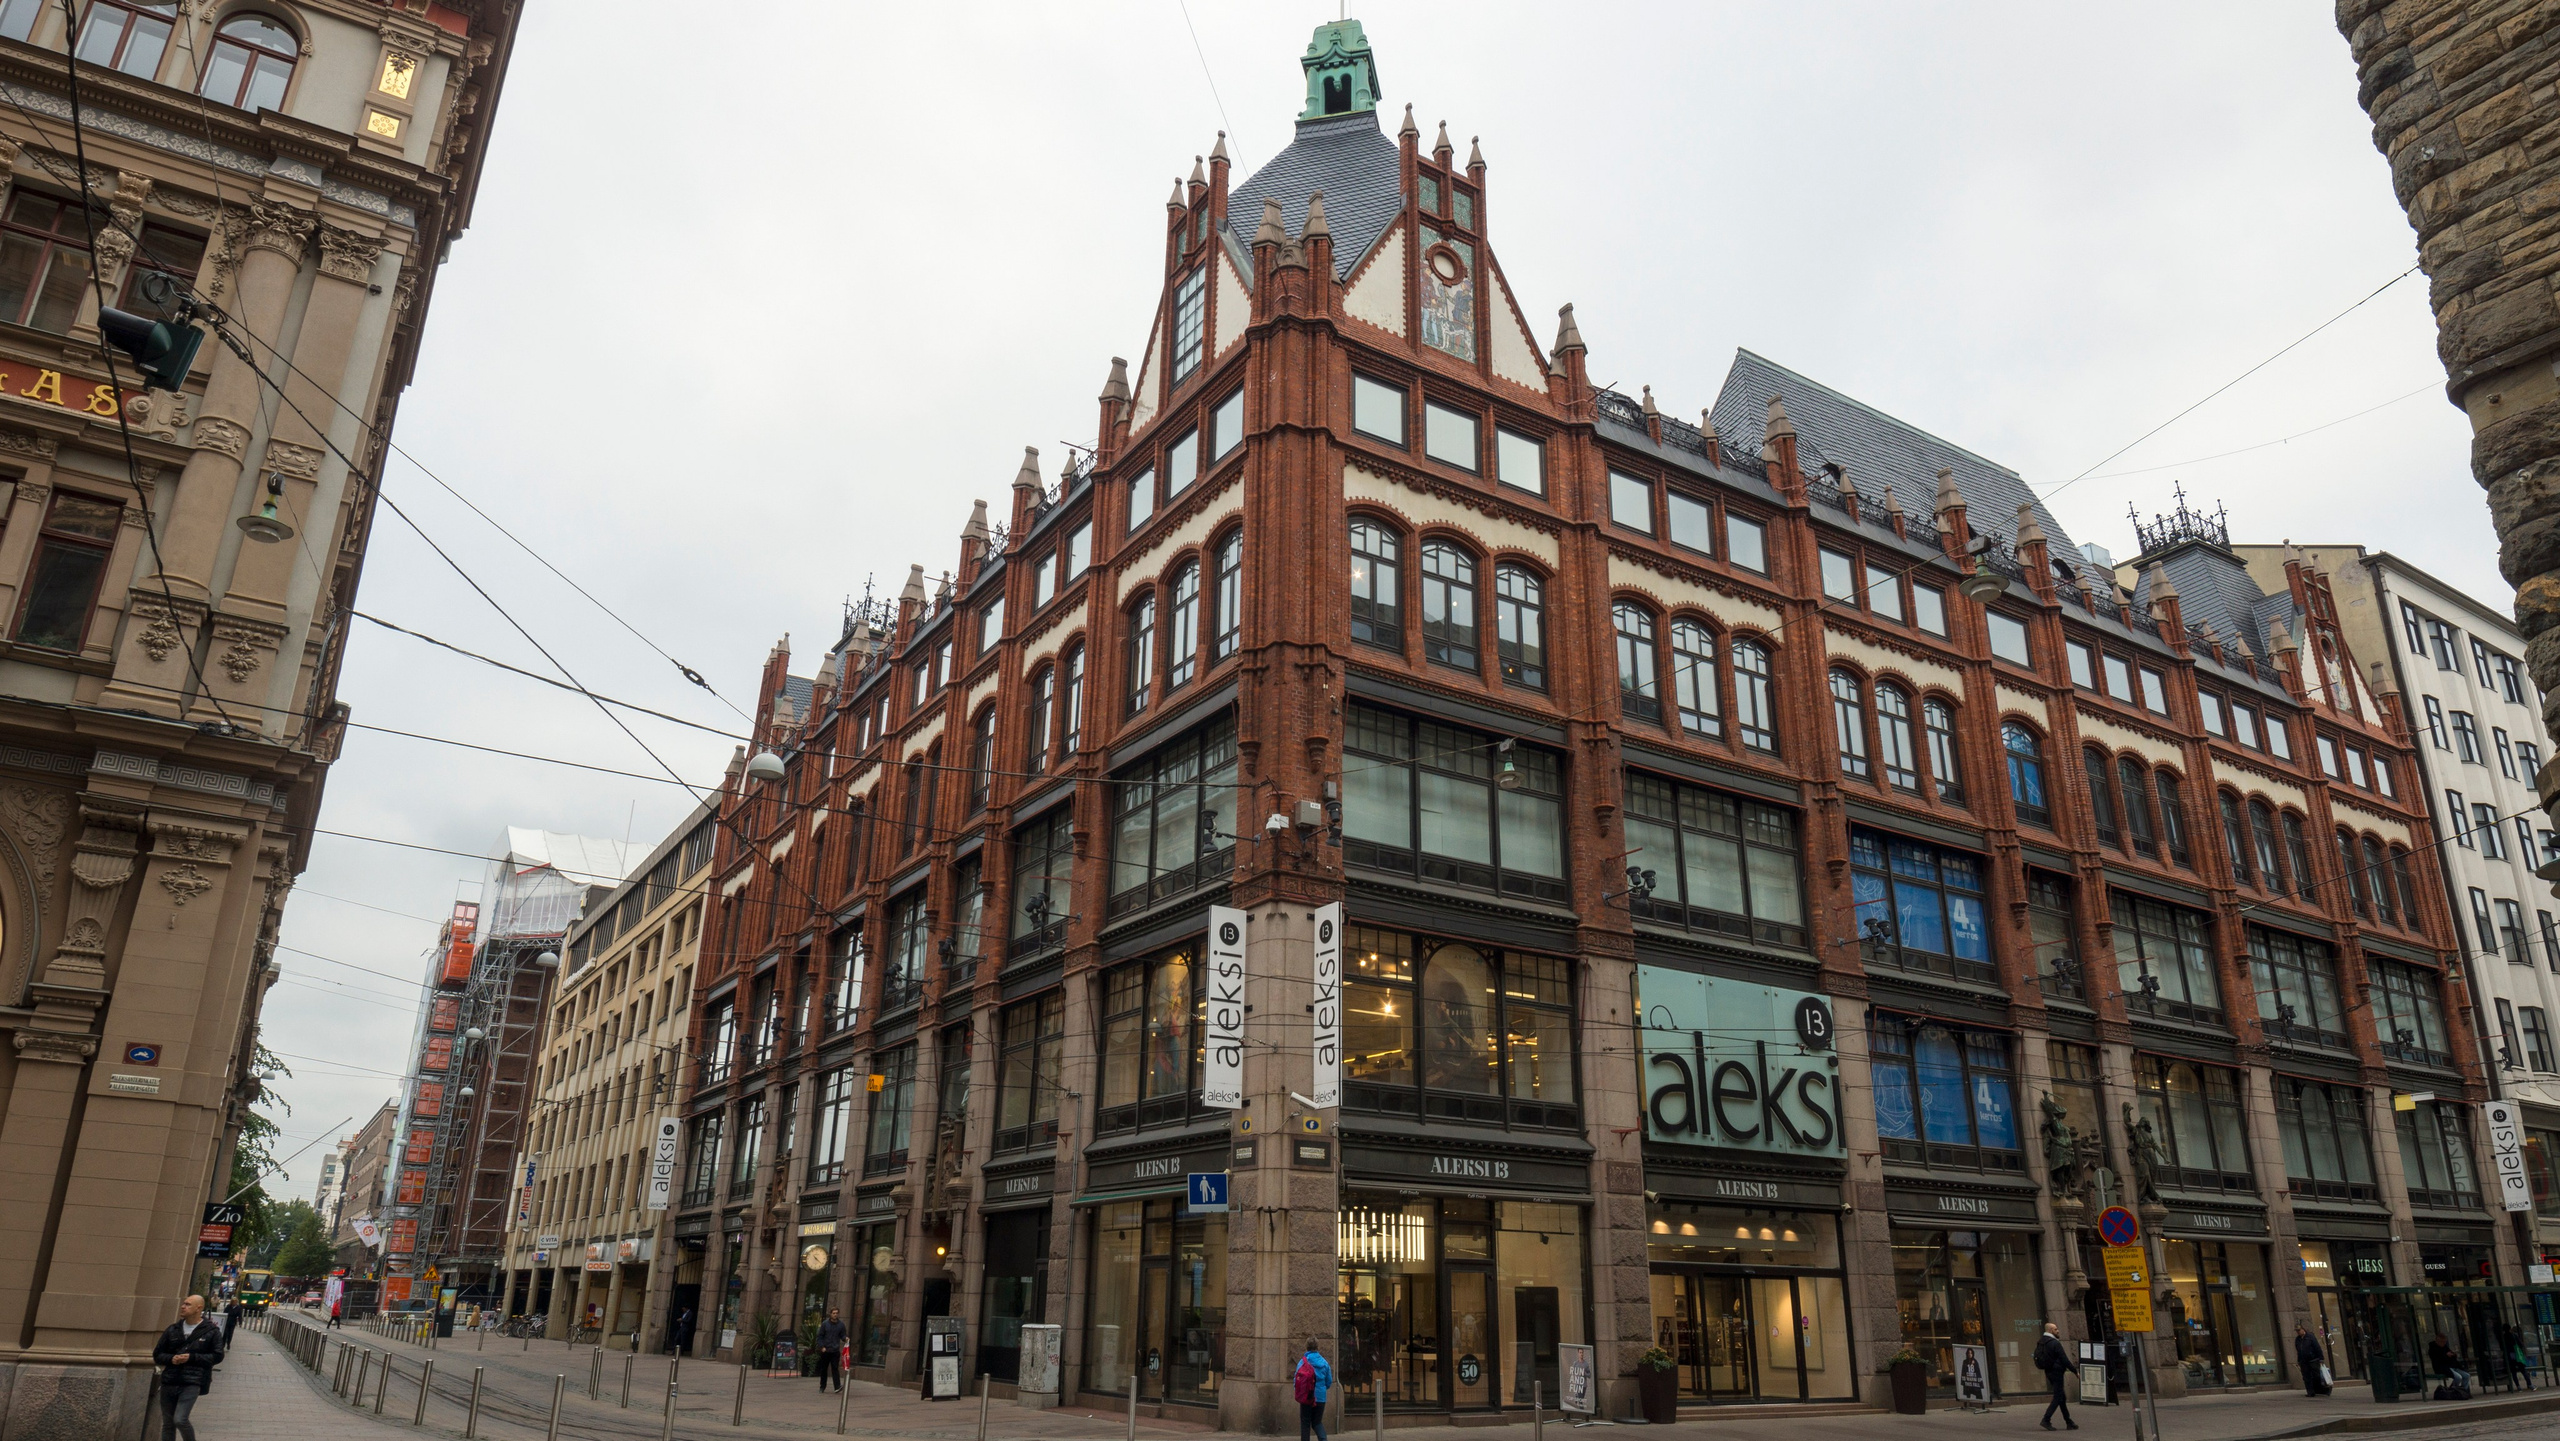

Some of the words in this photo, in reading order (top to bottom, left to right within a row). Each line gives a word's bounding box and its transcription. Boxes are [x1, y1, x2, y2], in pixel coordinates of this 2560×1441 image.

[1954, 898, 1976, 931] 4.
[1224, 926, 1235, 940] 13
[1322, 924, 1330, 938] 13
[1956, 929, 1979, 941] kerros
[1209, 950, 1243, 1068] aleksi
[1314, 948, 1336, 1066] aleksi
[1805, 1008, 1826, 1037] 13
[1207, 1090, 1234, 1103] aleksi
[1314, 1089, 1333, 1104] aleksi
[1651, 1031, 1847, 1153] aleksi
[653, 1138, 675, 1192] aleksi
[2491, 1125, 2524, 1189] aleksi
[1134, 1158, 1168, 1178] ALEKSI
[1171, 1157, 1180, 1174] 13
[1431, 1156, 1490, 1177] ALEKSI
[1494, 1161, 1509, 1179] 13
[521, 1161, 537, 1212] INTERSPORT
[1005, 1176, 1031, 1194] ALEKSI
[1032, 1176, 1039, 1191] 13
[1716, 1180, 1764, 1197] ALEKSI
[1766, 1183, 1779, 1199] 13
[1938, 1196, 1977, 1212] ALEKSI
[1979, 1199, 1989, 1213] 13
[210, 1206, 242, 1223] Zio
[2193, 1214, 2222, 1228] ALEKSI
[2222, 1216, 2231, 1229] 13
[1148, 1357, 1160, 1371] 50
[1461, 1364, 1478, 1378] 50
[1569, 1366, 1585, 1376] RUN
[1569, 1375, 1585, 1385] AND
[1569, 1383, 1584, 1394] FUN
